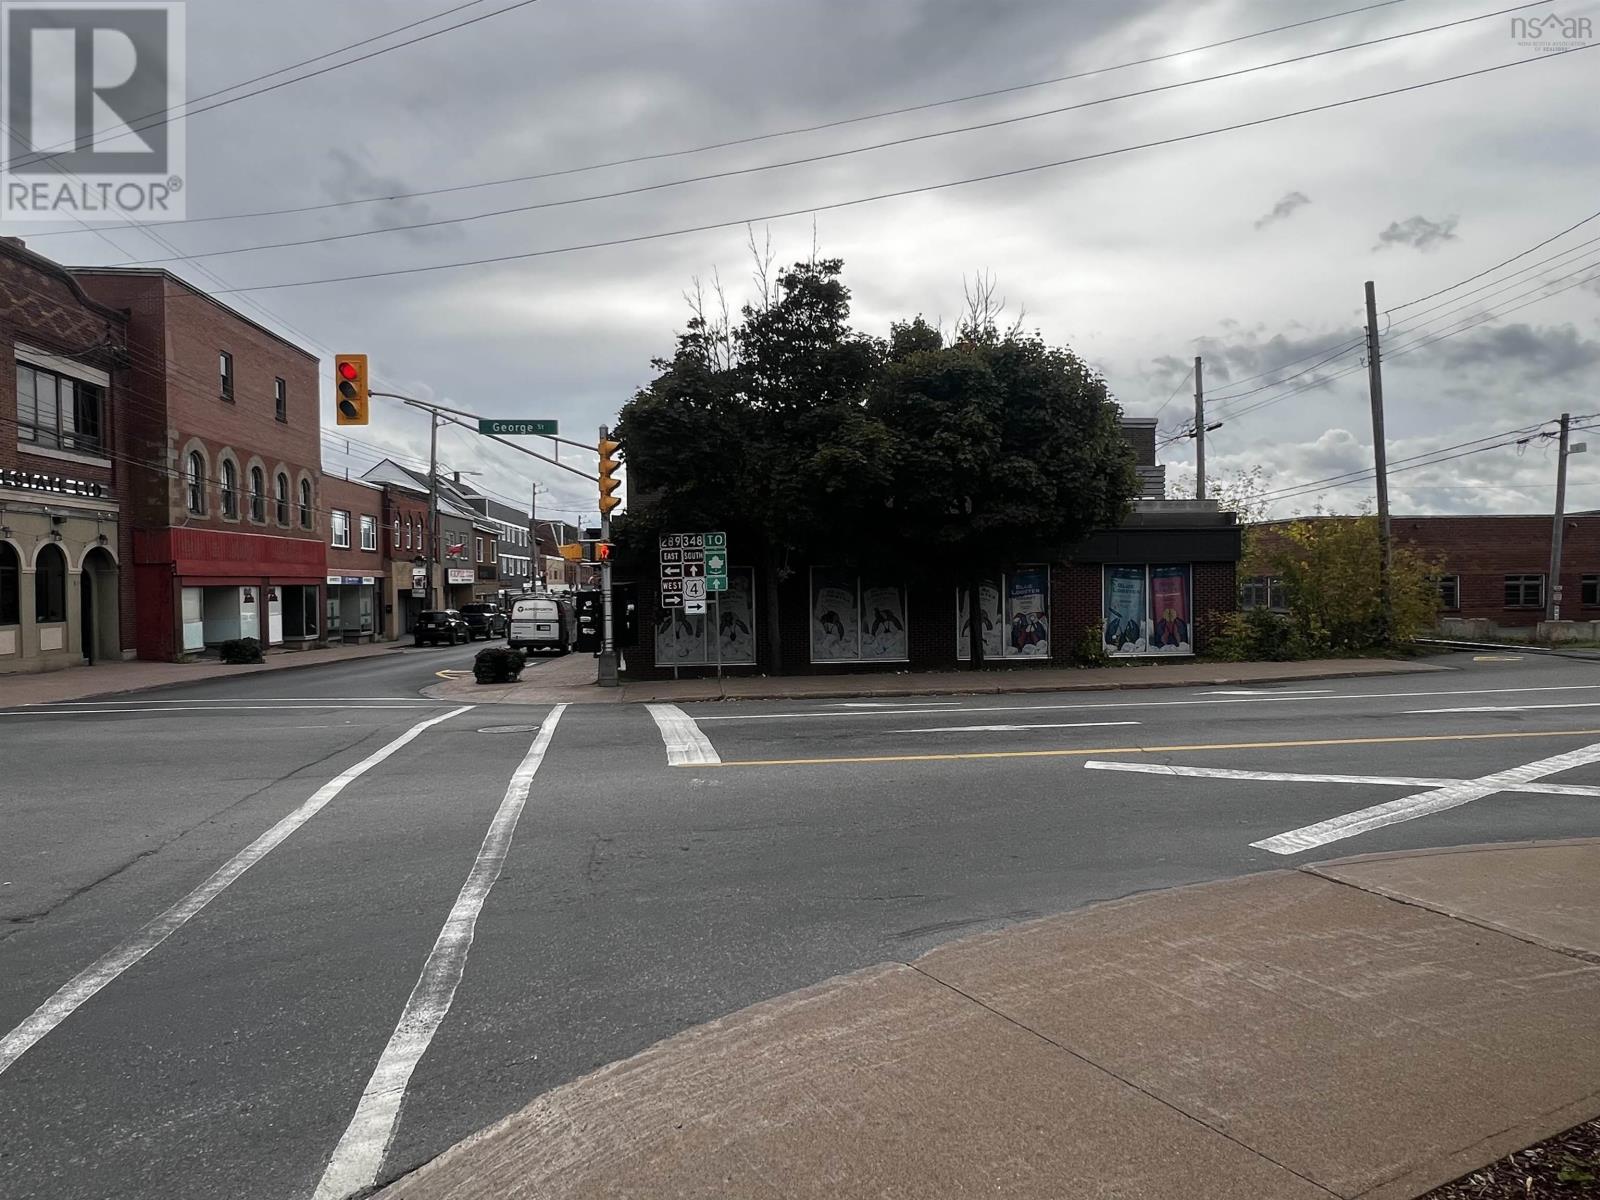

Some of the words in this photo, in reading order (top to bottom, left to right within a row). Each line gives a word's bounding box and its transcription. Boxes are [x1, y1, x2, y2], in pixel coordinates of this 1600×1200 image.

[492, 422, 533, 434] George
[661, 536, 681, 547] 289
[683, 536, 703, 546] 348
[707, 535, 723, 545] TO
[663, 552, 679, 560] EAST
[684, 552, 704, 560] SOUTH
[662, 582, 682, 590] WEST
[690, 583, 698, 595] 4
